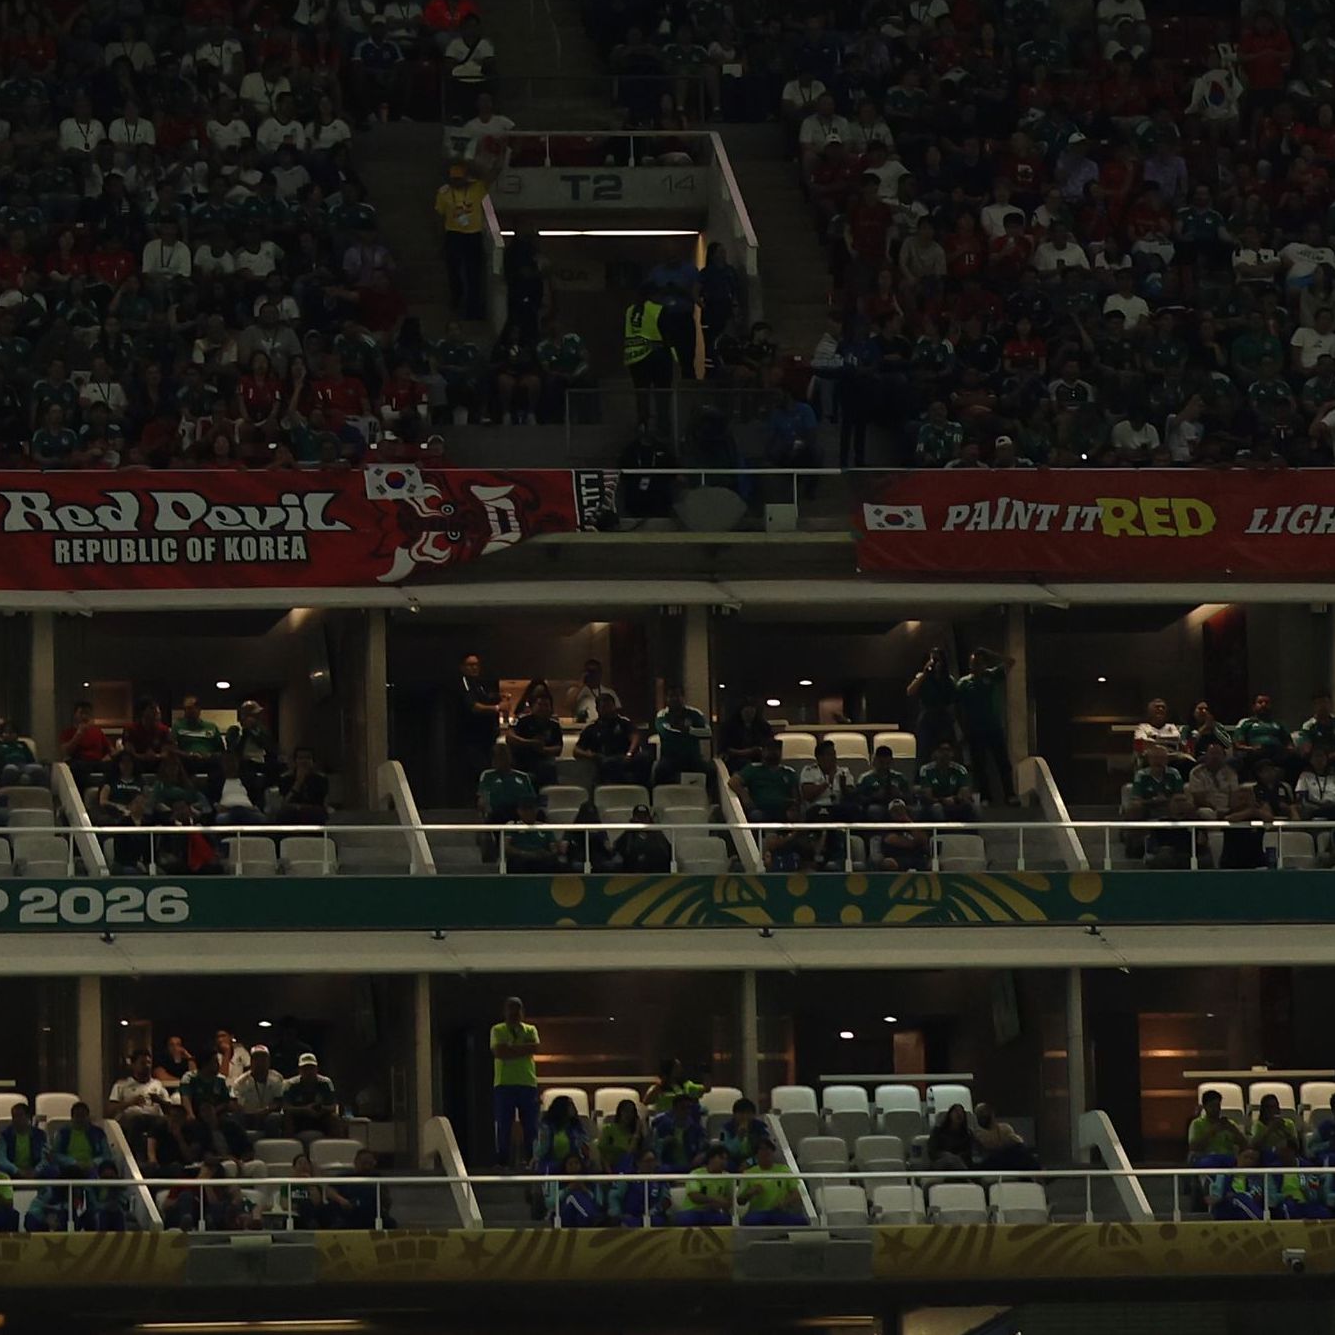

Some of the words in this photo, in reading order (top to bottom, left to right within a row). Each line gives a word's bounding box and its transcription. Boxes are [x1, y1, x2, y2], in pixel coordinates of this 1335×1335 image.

[561, 175, 623, 201] T2
[662, 175, 696, 194] 14
[150, 490, 353, 532] Devil
[942, 497, 1060, 532] PAINT
[1061, 506, 1104, 531] IT
[1096, 497, 1217, 538] RED
[54, 538, 178, 564] REPUBLIC
[186, 538, 217, 562] OF
[224, 536, 307, 562] KOREA
[19, 886, 190, 923] 2026
